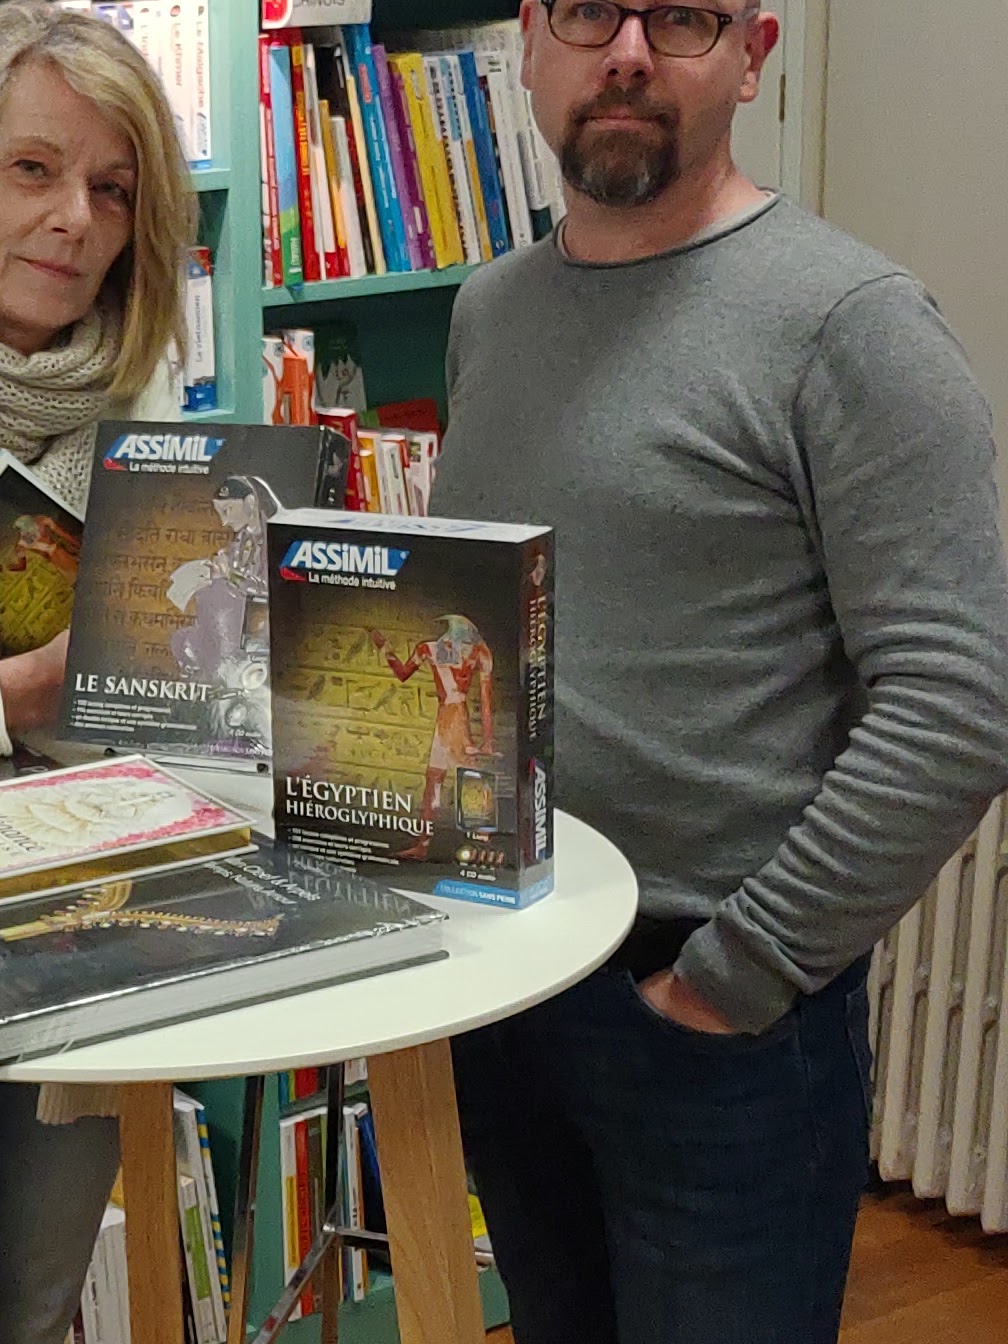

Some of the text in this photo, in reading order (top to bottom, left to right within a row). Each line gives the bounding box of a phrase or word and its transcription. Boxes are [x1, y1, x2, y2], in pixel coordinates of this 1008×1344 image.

[308, 571, 397, 591] La méthode intuitive
[75, 673, 212, 703] LE SANSKRIT
[286, 774, 413, 814] L'ÉGYPTIEN
[286, 799, 435, 838] HIÉROGLYPHIQUE
